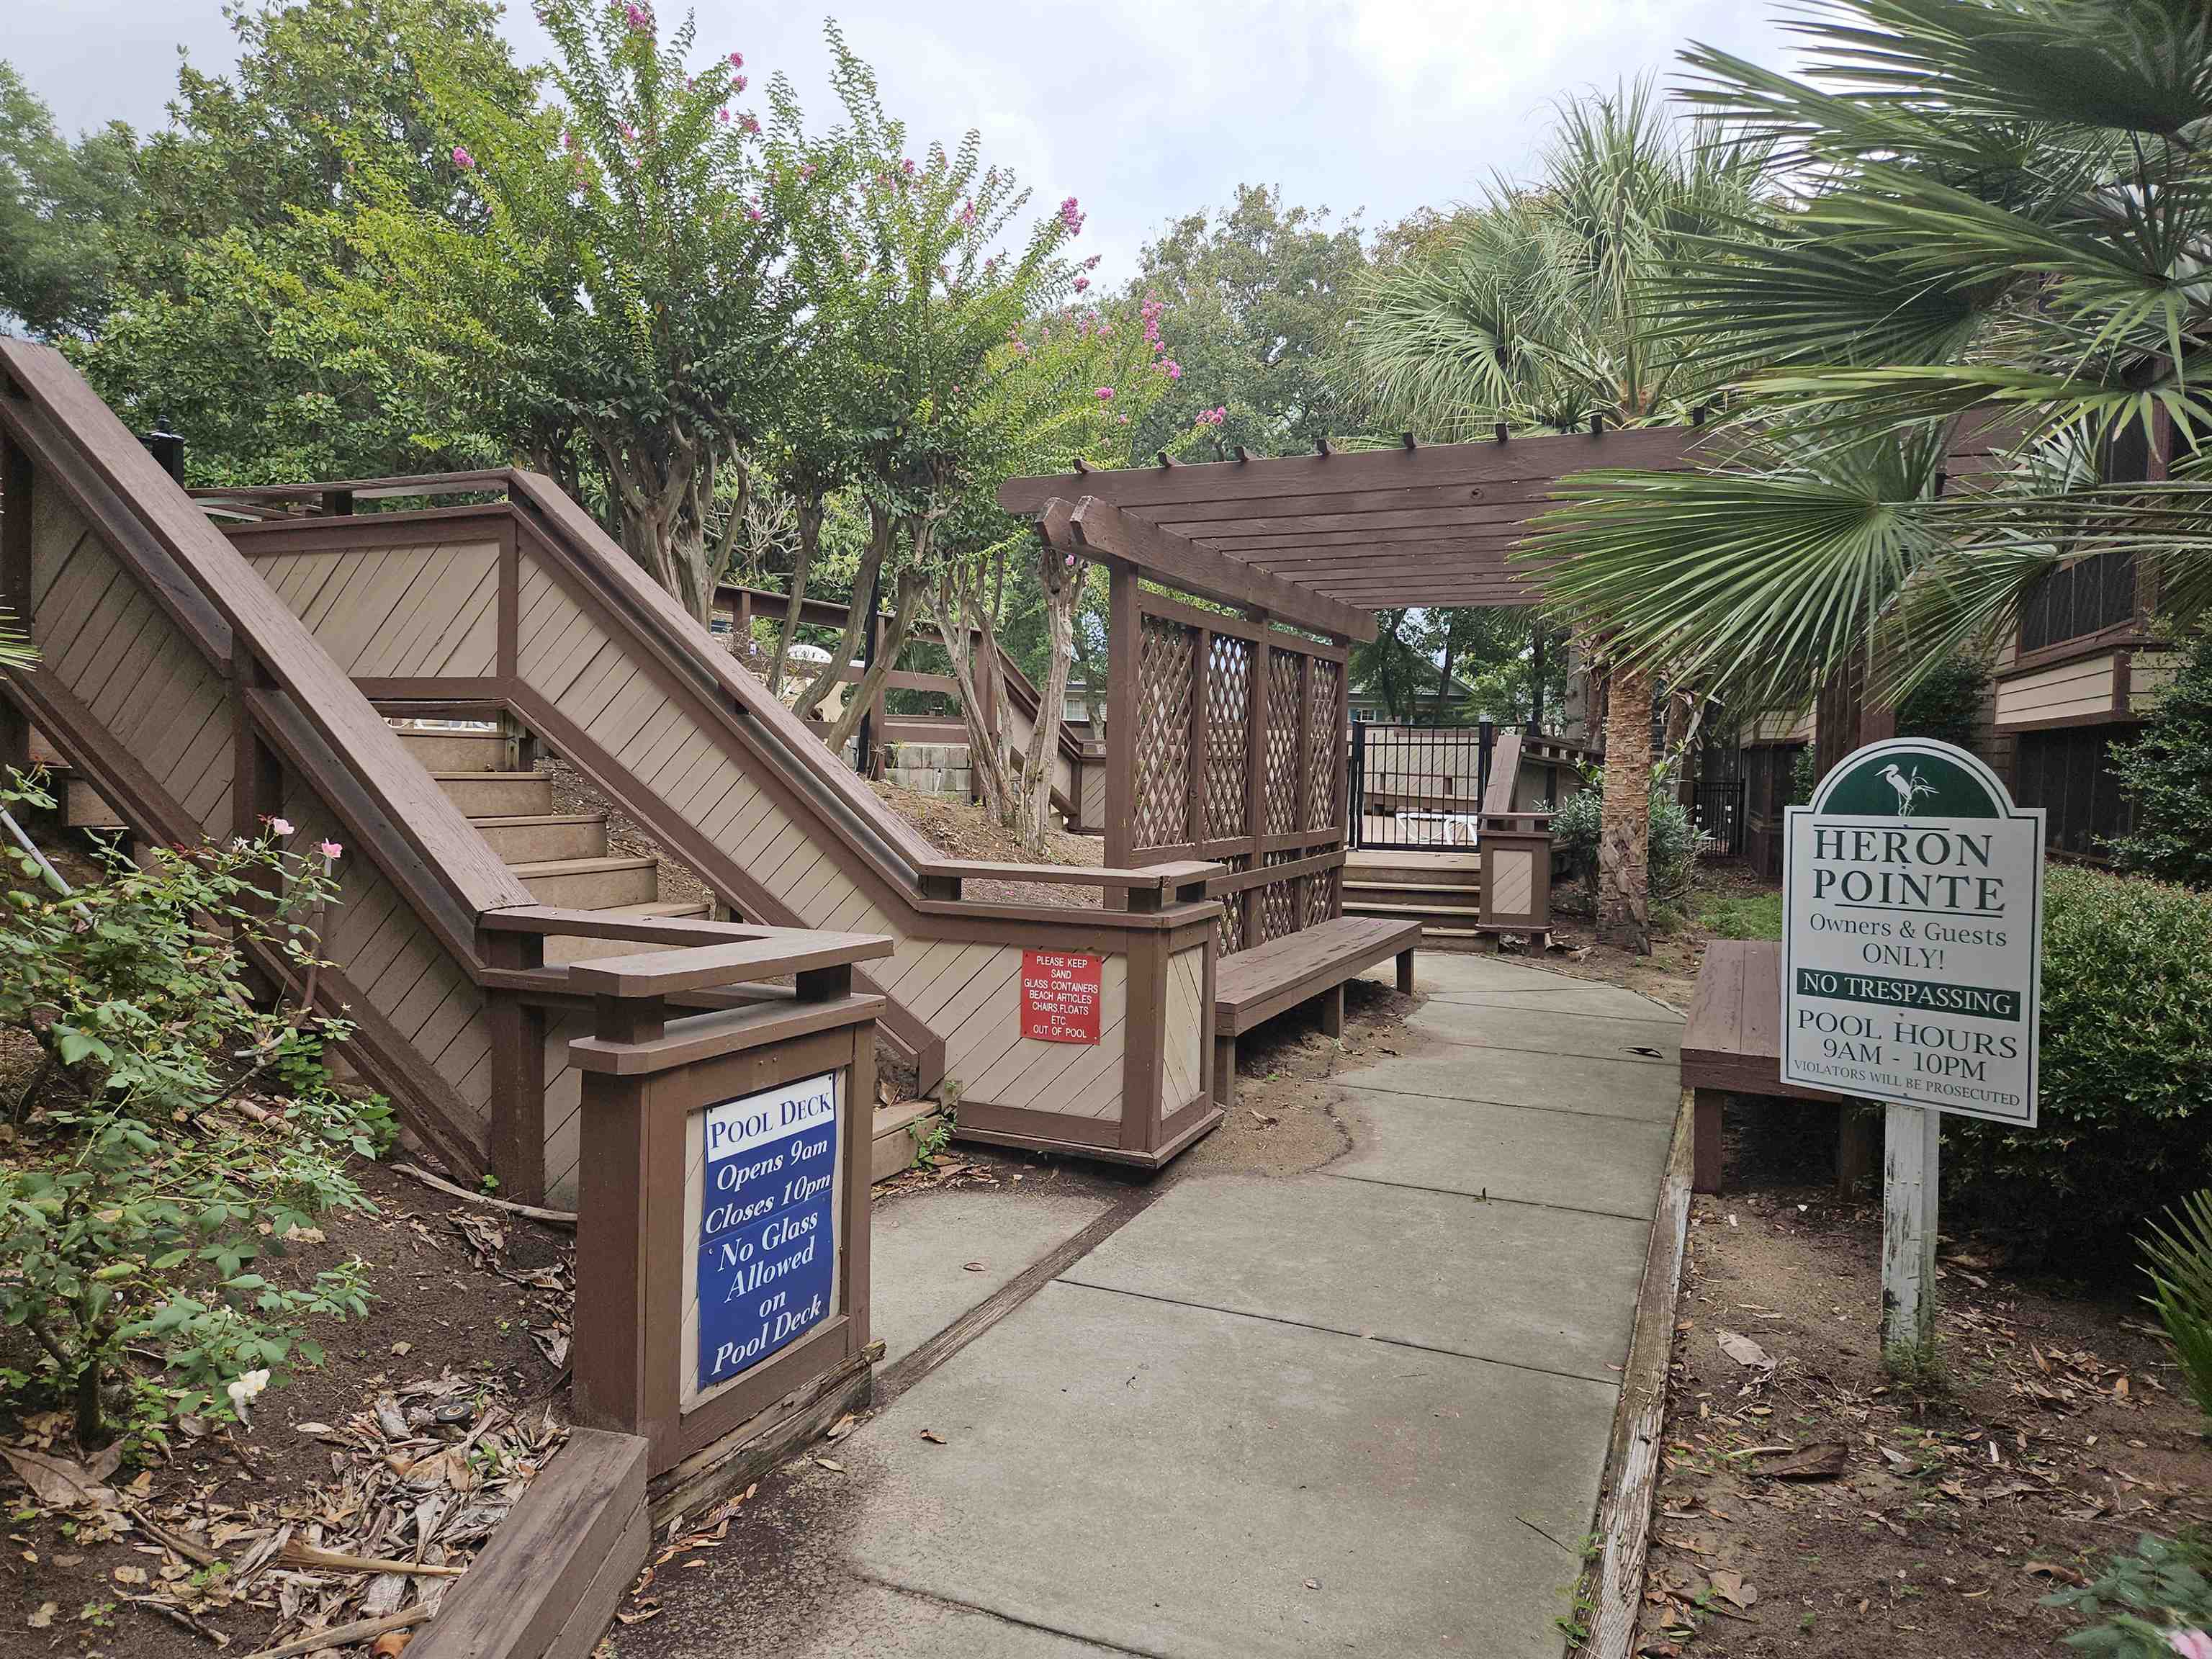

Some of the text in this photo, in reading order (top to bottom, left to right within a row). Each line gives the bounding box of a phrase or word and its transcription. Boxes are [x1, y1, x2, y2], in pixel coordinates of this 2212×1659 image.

[1812, 830, 1993, 868] HERON
[1812, 868, 2005, 912] POINTE
[1809, 912, 2007, 947] Owners & Guests
[1036, 956, 1087, 968] PLEASE KEEP
[1051, 968, 1071, 979] SAND
[1862, 943, 1944, 970] ONLY!
[1024, 979, 1099, 994] GLASS CONTAINERS
[1030, 990, 1092, 1004] BEACH ARTICLES
[1803, 972, 2012, 1015] NO TRESPASSING
[1033, 1025, 1087, 1038] OUT OF POOL
[1797, 1009, 2018, 1059] POOL HOURS
[1823, 1038, 1882, 1065] 9AM
[1913, 1051, 1987, 1082] 10PM
[1794, 1059, 2020, 1107] VIOLATORS WILL BE PROSECUTED
[709, 1092, 832, 1150] POOL DECK
[716, 1137, 828, 1192] Opens 9am
[705, 1174, 832, 1234] Closes 10pm
[717, 1210, 819, 1272] No Glass
[723, 1234, 816, 1303] Allowed
[758, 1290, 786, 1318] on
[711, 1292, 822, 1375] Pool Deck
